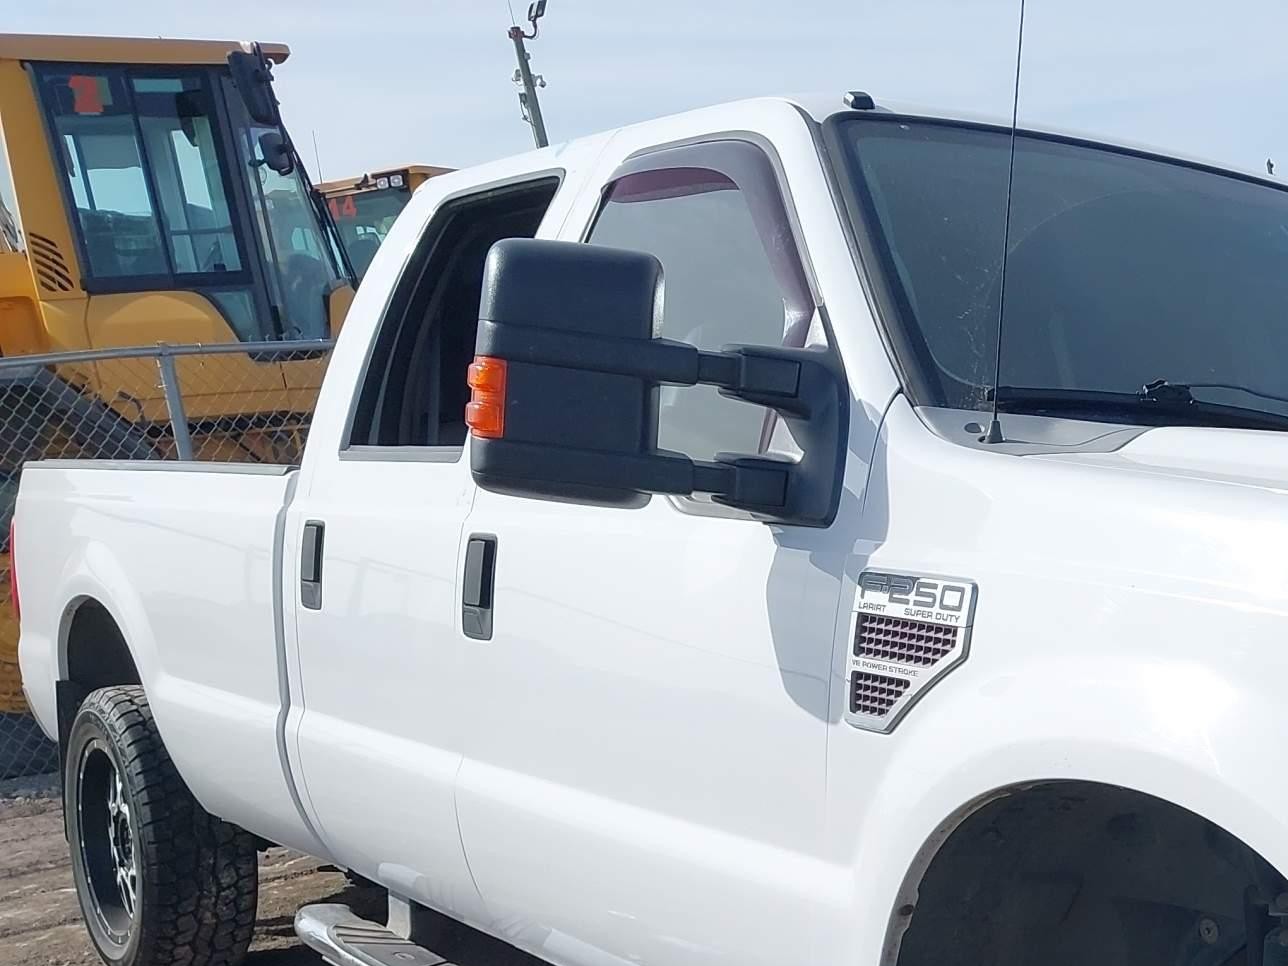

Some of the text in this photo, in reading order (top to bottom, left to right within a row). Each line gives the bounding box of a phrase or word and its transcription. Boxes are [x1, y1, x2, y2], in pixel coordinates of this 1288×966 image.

[859, 573, 966, 612] F-250
[858, 601, 887, 613] LARIAT
[903, 607, 961, 624] SUPER DUTY
[862, 661, 888, 672] POWER
[888, 666, 920, 678] STROKE
